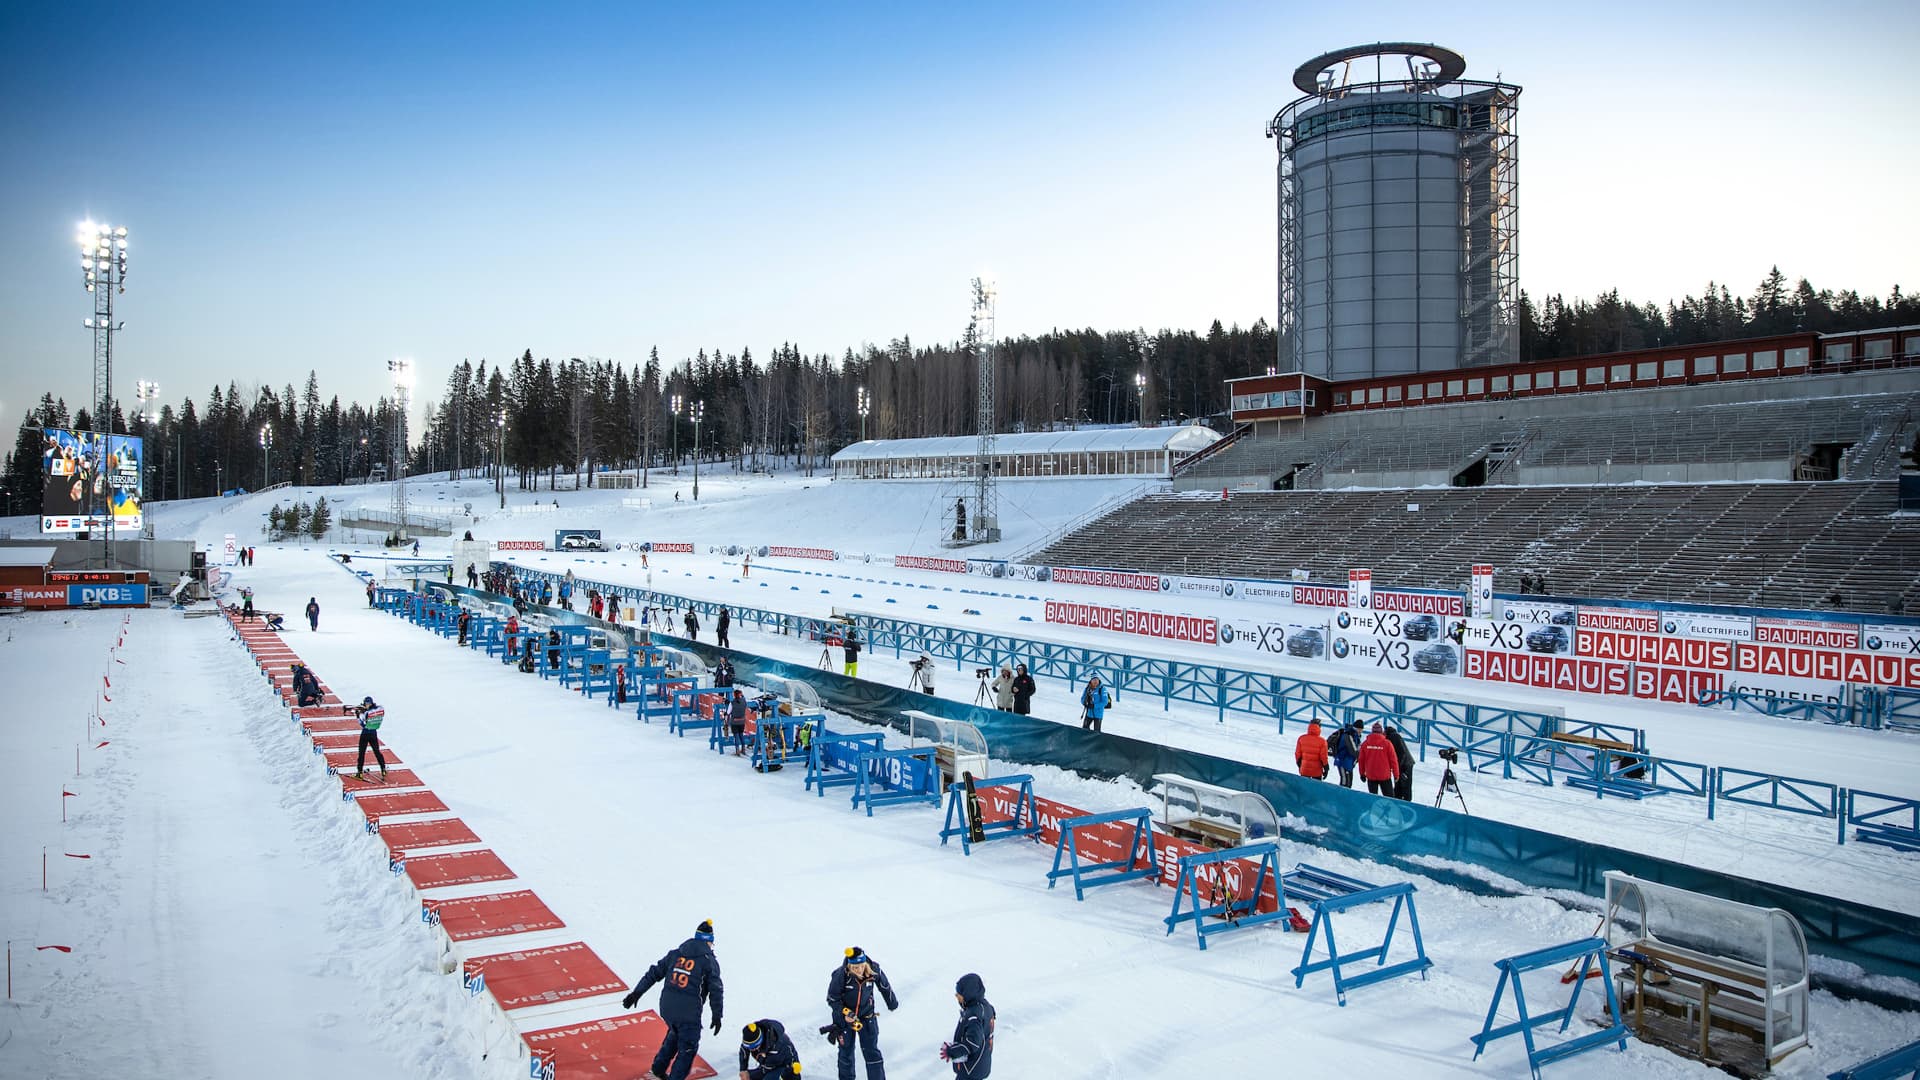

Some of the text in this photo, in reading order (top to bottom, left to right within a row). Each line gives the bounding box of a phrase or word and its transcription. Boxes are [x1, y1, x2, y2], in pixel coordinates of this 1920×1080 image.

[499, 541, 544, 549] BAUHAUS
[653, 544, 692, 552] BAUHAUS
[896, 557, 928, 569] BAUHAUS
[929, 558, 966, 573] BAUHAUS
[981, 562, 992, 577] X3
[1024, 566, 1036, 581] X3
[1053, 569, 1102, 585] BAUHAUS
[1104, 574, 1159, 590] BAUHAUS
[82, 588, 119, 601] DKB
[1180, 582, 1220, 592] ELECTRIFIED
[1245, 587, 1291, 598] ELECTRIFIED
[1294, 588, 1348, 606] BAUHA
[1375, 594, 1461, 615] BAUHAUS
[1046, 603, 1123, 628] BAUHAUS
[1352, 612, 1400, 637] THE X3
[1515, 609, 1551, 624] THE X3
[1579, 614, 1657, 632] BAUHAUS
[1127, 611, 1215, 641] BAUHAUS
[1467, 621, 1523, 649] THE X3
[1691, 625, 1749, 637] ELECTRIFIED
[1235, 625, 1285, 654] THE X3
[1758, 629, 1857, 647] BAUHAUS
[1886, 636, 1920, 654] THE X
[1351, 639, 1410, 670] THE X3
[1578, 633, 1729, 667] BAUHAUS
[1467, 654, 1626, 691] BAUHAUS
[1637, 671, 1714, 701] BAU
[993, 797, 1062, 833] VIESSMAN
[430, 909, 440, 928] 26
[675, 957, 695, 971] 20
[472, 974, 484, 997] 27
[670, 972, 689, 988] 19
[542, 1062, 555, 1080] 28
